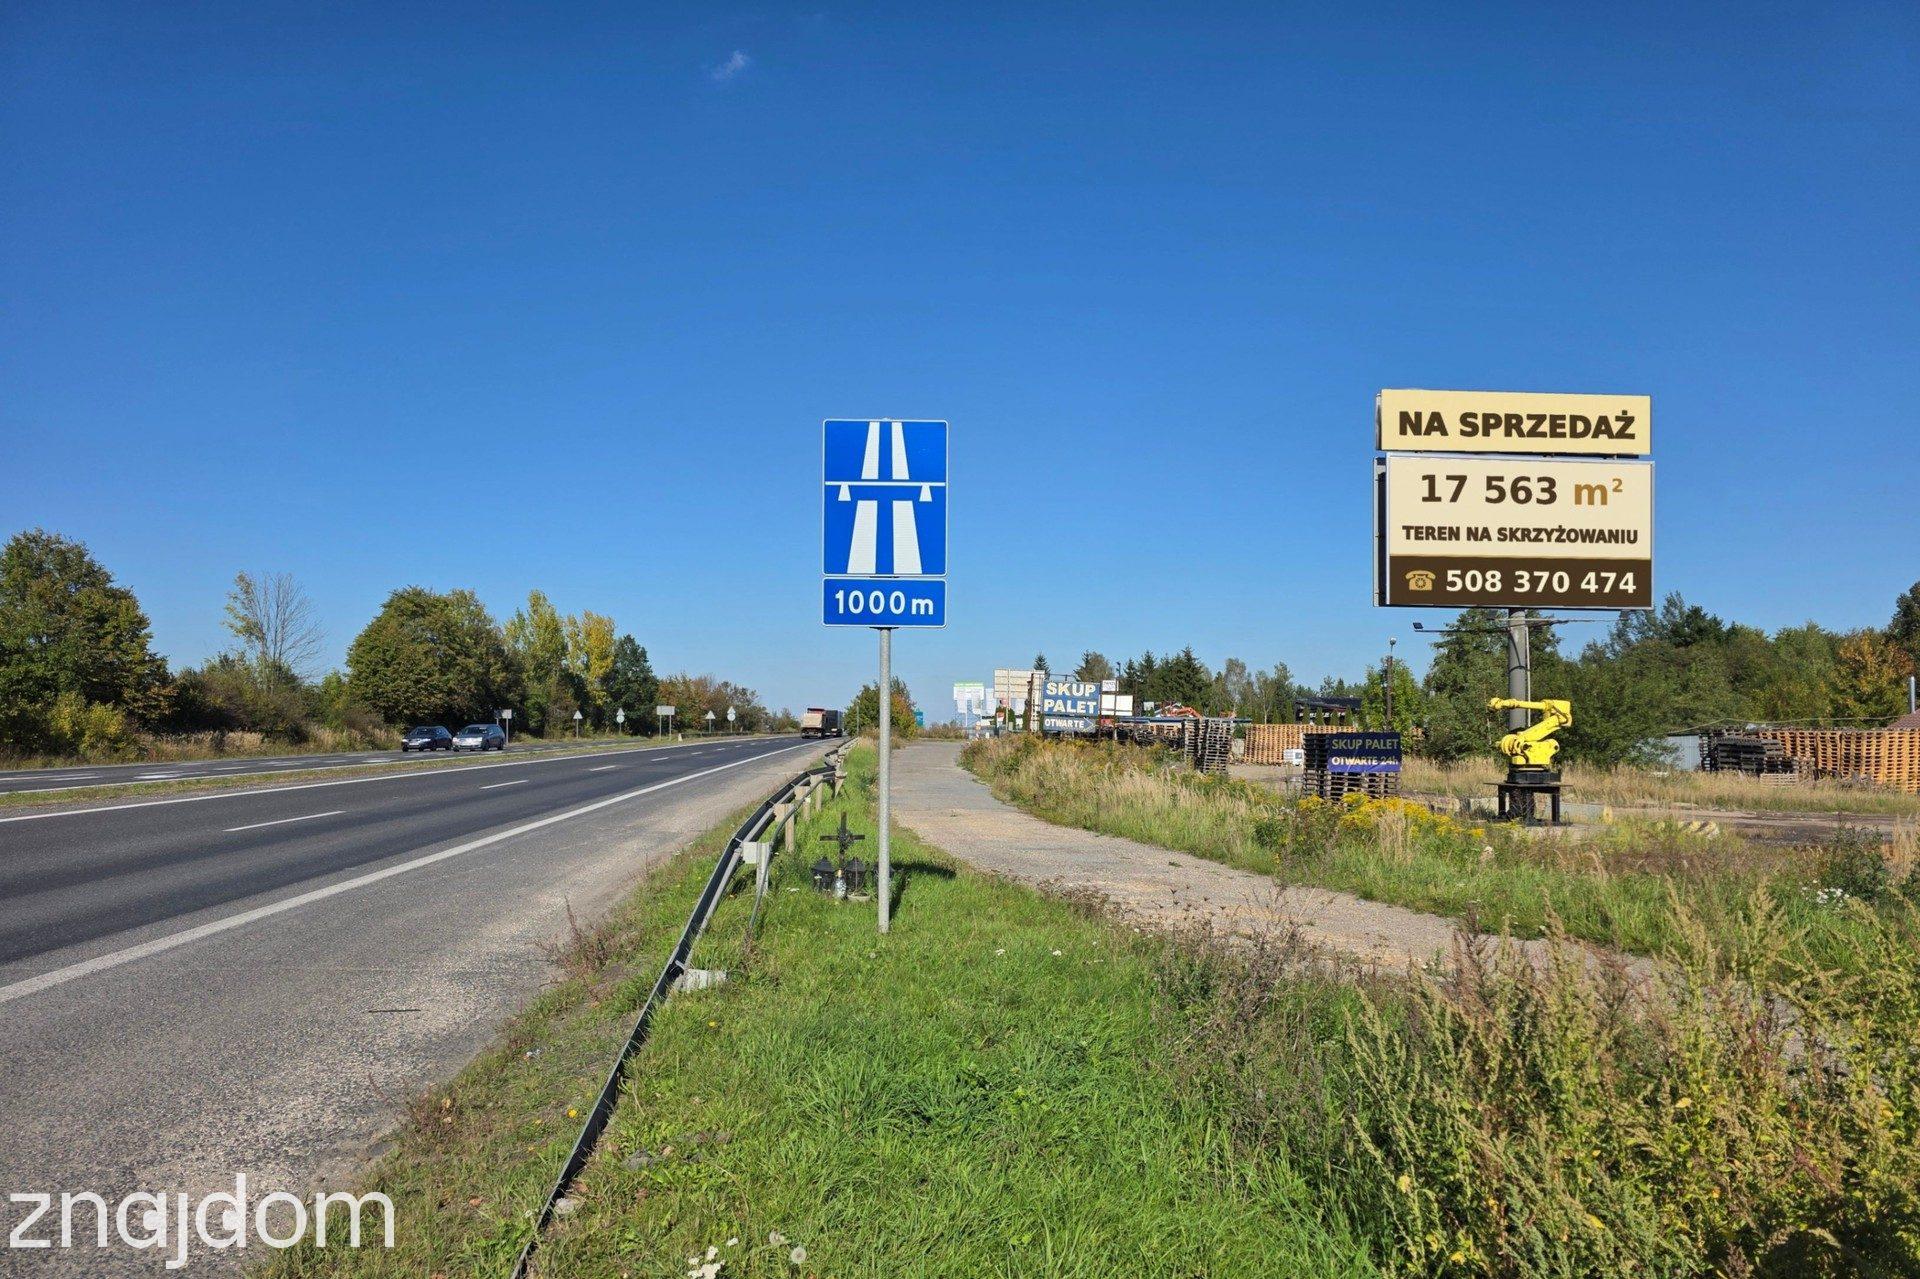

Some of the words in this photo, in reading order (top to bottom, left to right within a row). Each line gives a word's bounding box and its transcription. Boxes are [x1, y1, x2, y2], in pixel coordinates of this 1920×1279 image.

[1399, 411, 1449, 437] NA
[1459, 410, 1636, 440] SPRZEDAŻ
[1421, 474, 1468, 503] 17
[1485, 475, 1558, 505] 563
[1402, 525, 1461, 541] TEREN
[1466, 526, 1492, 542] NA
[1497, 525, 1639, 544] SKRZYŻOWANIU
[1446, 570, 1502, 593] 508
[1513, 571, 1570, 593] 370
[1580, 572, 1637, 594] 474
[1046, 682, 1096, 697] SKUP
[1044, 699, 1097, 714] PALET
[1044, 718, 1085, 728] OTWARTE
[1332, 739, 1363, 749] SKUP
[1365, 739, 1399, 749] PALET
[1331, 756, 1378, 765] OTWARTE
[1381, 756, 1399, 765] 24h
